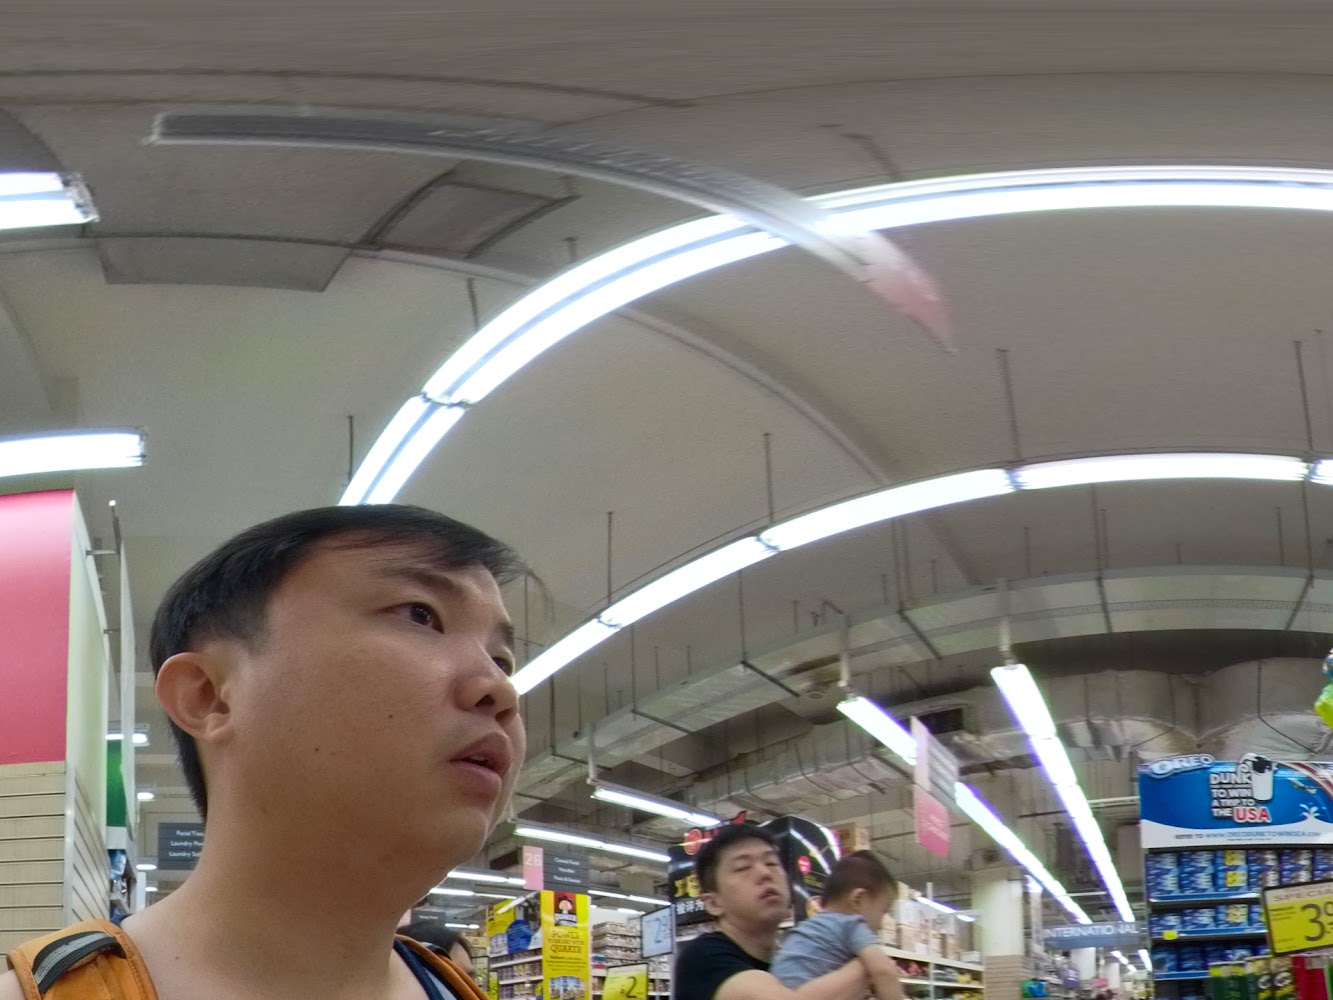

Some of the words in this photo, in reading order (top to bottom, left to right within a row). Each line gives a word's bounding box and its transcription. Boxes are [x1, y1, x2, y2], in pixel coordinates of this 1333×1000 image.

[1150, 755, 1213, 776] OREO
[1210, 772, 1252, 785] DUNK
[1211, 789, 1226, 798] TO
[1229, 788, 1251, 798] WIN
[1241, 798, 1255, 806] TO
[1211, 808, 1232, 817] THE
[1233, 806, 1271, 824] USA
[524, 853, 541, 866] 26
[550, 944, 582, 953] QUAKER
